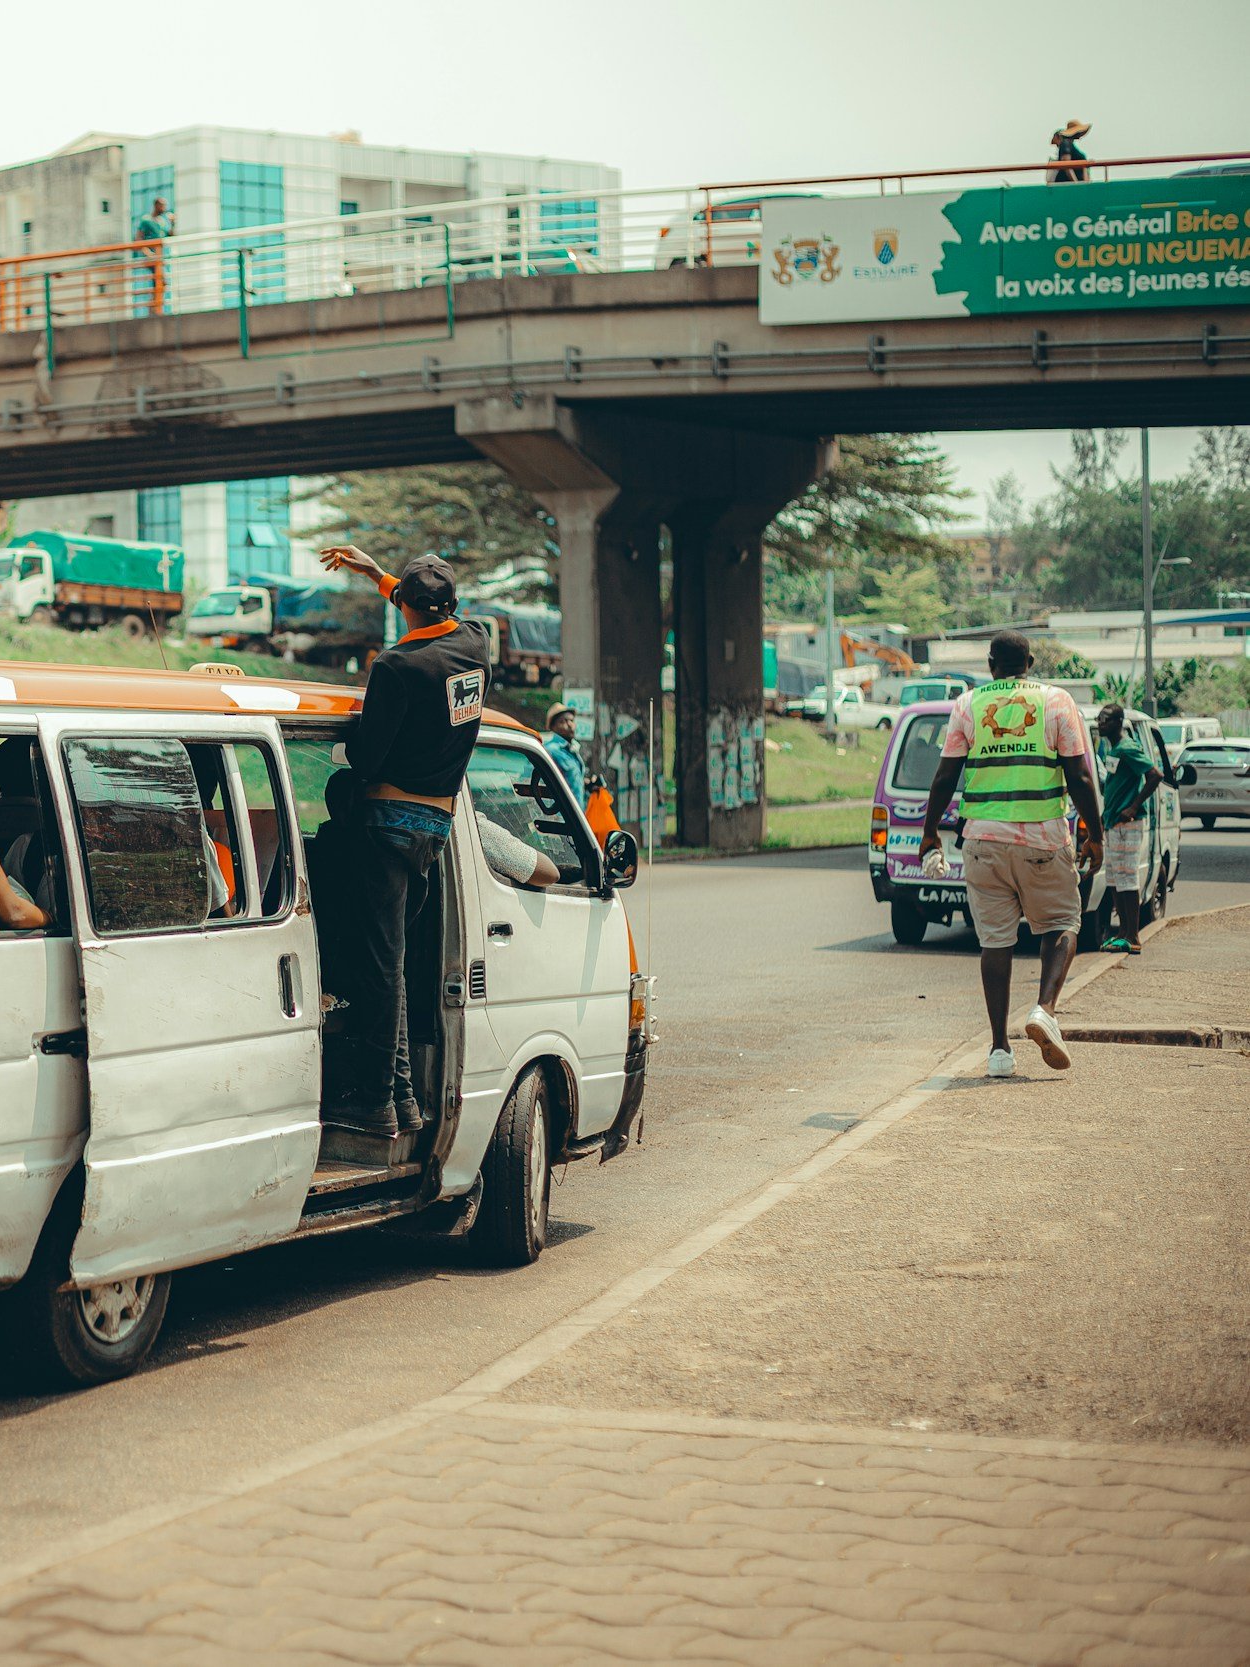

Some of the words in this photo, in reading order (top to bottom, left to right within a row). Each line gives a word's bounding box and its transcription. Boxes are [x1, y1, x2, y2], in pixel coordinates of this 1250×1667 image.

[980, 221, 1041, 245] Avec
[1046, 216, 1068, 240] le
[1073, 210, 1171, 239] Général
[1176, 208, 1238, 233] Brice
[1055, 243, 1140, 269] OLIGUI
[1147, 237, 1250, 265] NGUEMA
[995, 275, 1020, 299] la
[1025, 272, 1076, 298] voix
[1079, 271, 1123, 295] des
[1127, 268, 1209, 299] jeunes
[453, 702, 480, 721] DELHAIZE
[980, 742, 1037, 755] AWENDJE
[918, 887, 939, 903] LA
